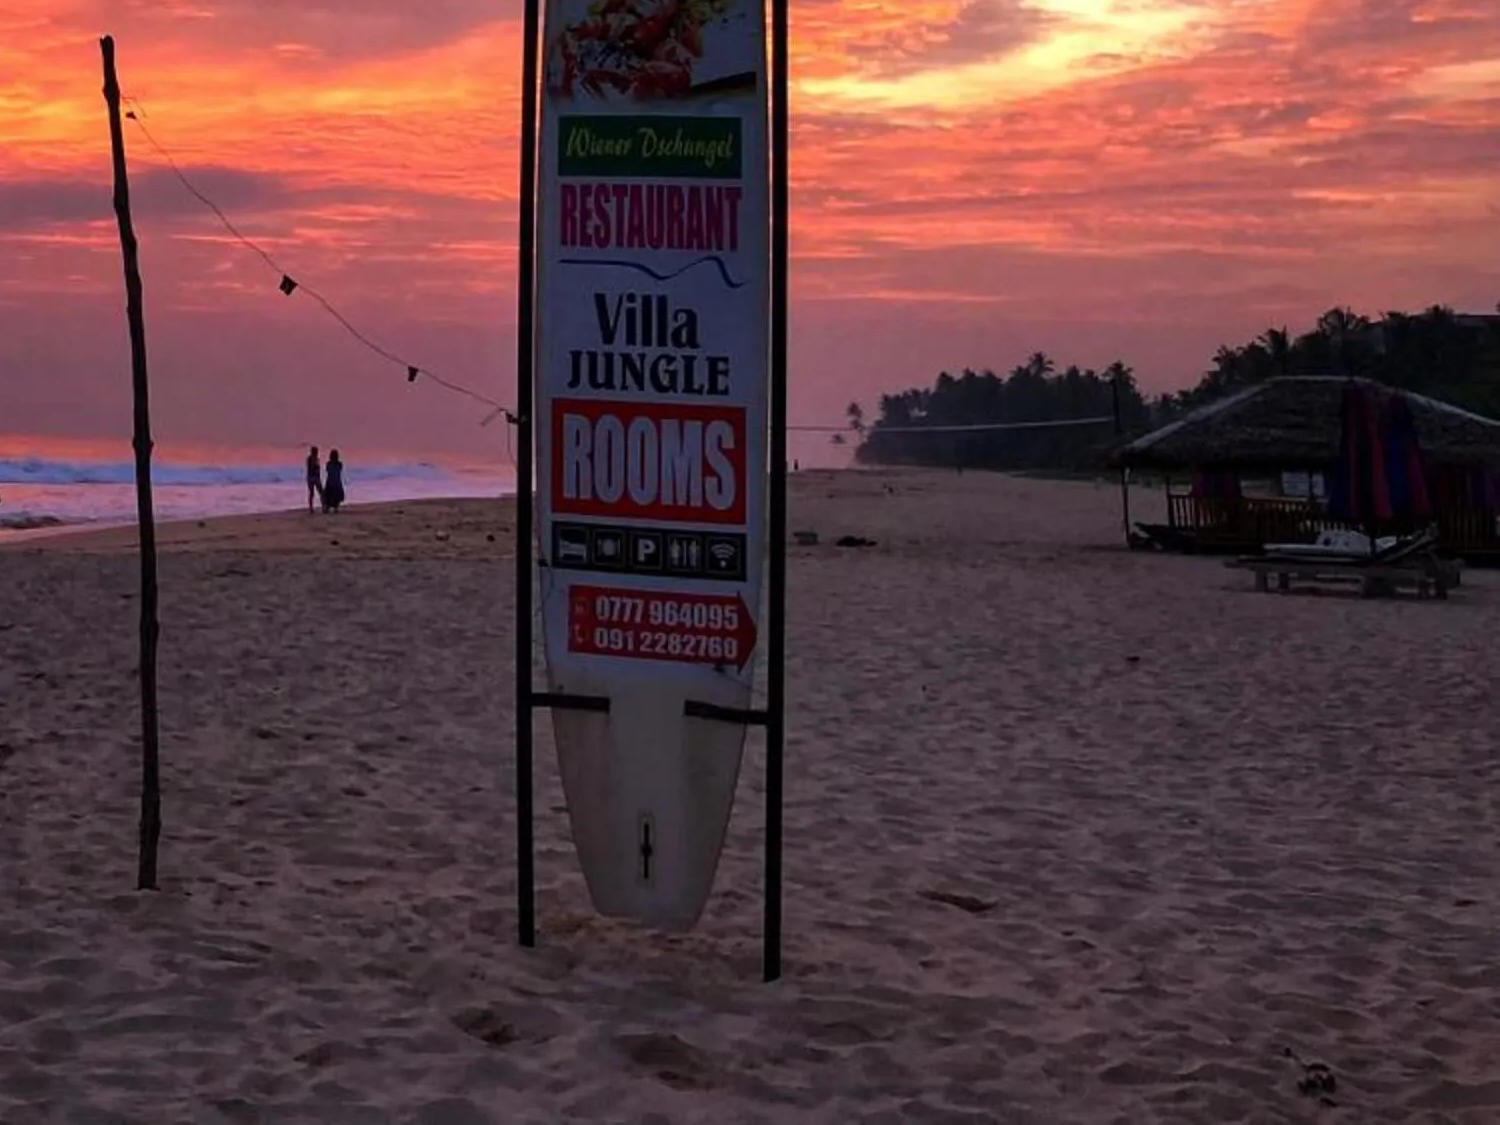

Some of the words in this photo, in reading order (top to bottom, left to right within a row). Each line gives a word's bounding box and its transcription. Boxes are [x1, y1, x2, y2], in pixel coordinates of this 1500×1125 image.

[566, 123, 632, 157] Wiener
[637, 127, 735, 168] Dschungel
[560, 183, 742, 251] RESTAURANT
[594, 292, 700, 348] Villa
[567, 350, 729, 396] JUNGLE
[562, 413, 735, 510] ROOMS
[596, 596, 644, 623] 0777
[648, 600, 739, 631] 964095
[595, 628, 634, 651] 091
